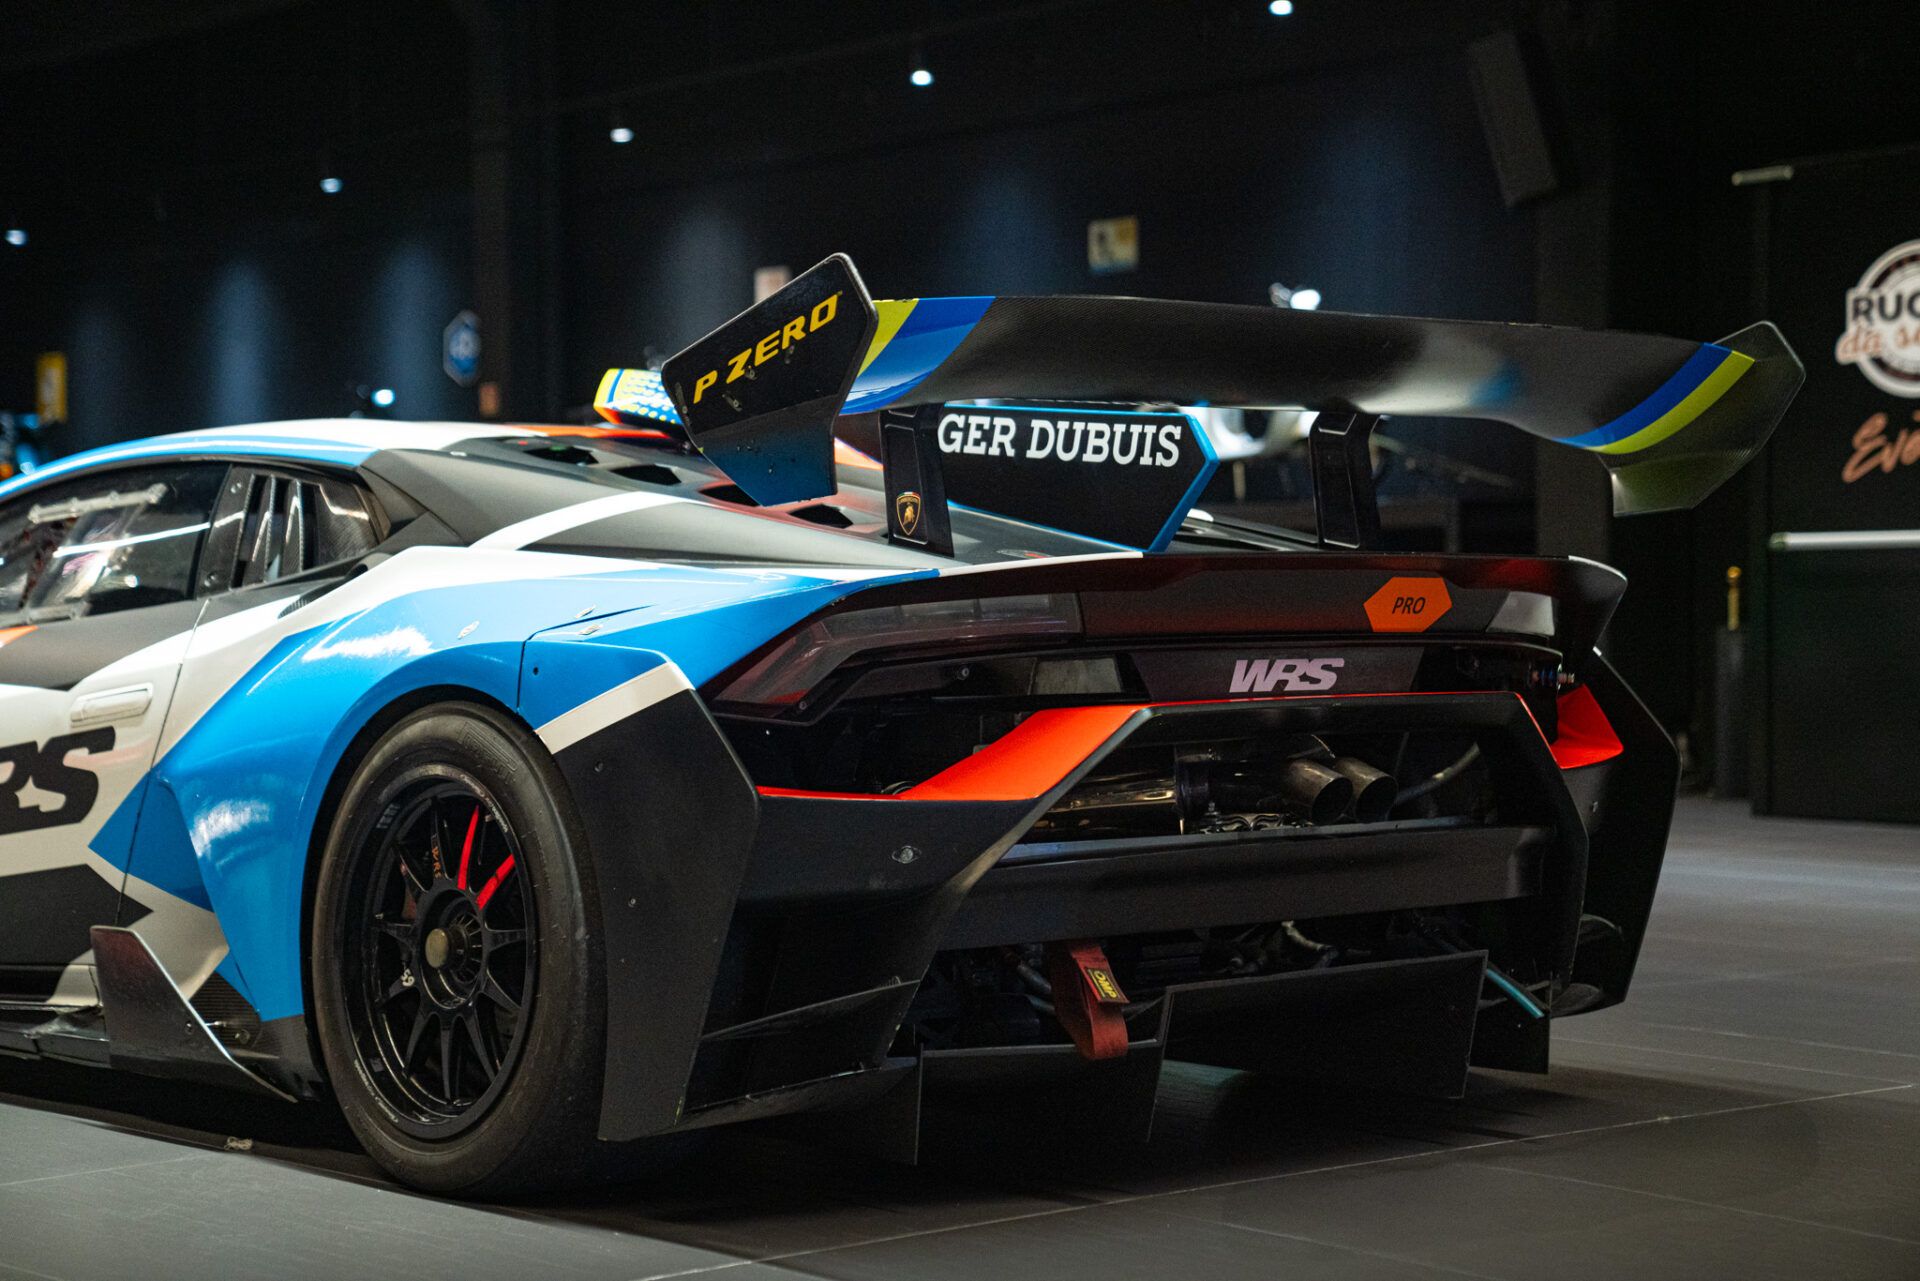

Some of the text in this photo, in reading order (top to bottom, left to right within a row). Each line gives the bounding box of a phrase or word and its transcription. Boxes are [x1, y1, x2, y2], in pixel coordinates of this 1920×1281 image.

[693, 293, 839, 404] P ZERO
[937, 413, 1182, 467] GER DUBUIS
[1392, 596, 1426, 614] PRO
[1229, 658, 1345, 693] WRS
[1094, 970, 1118, 999] OMP
